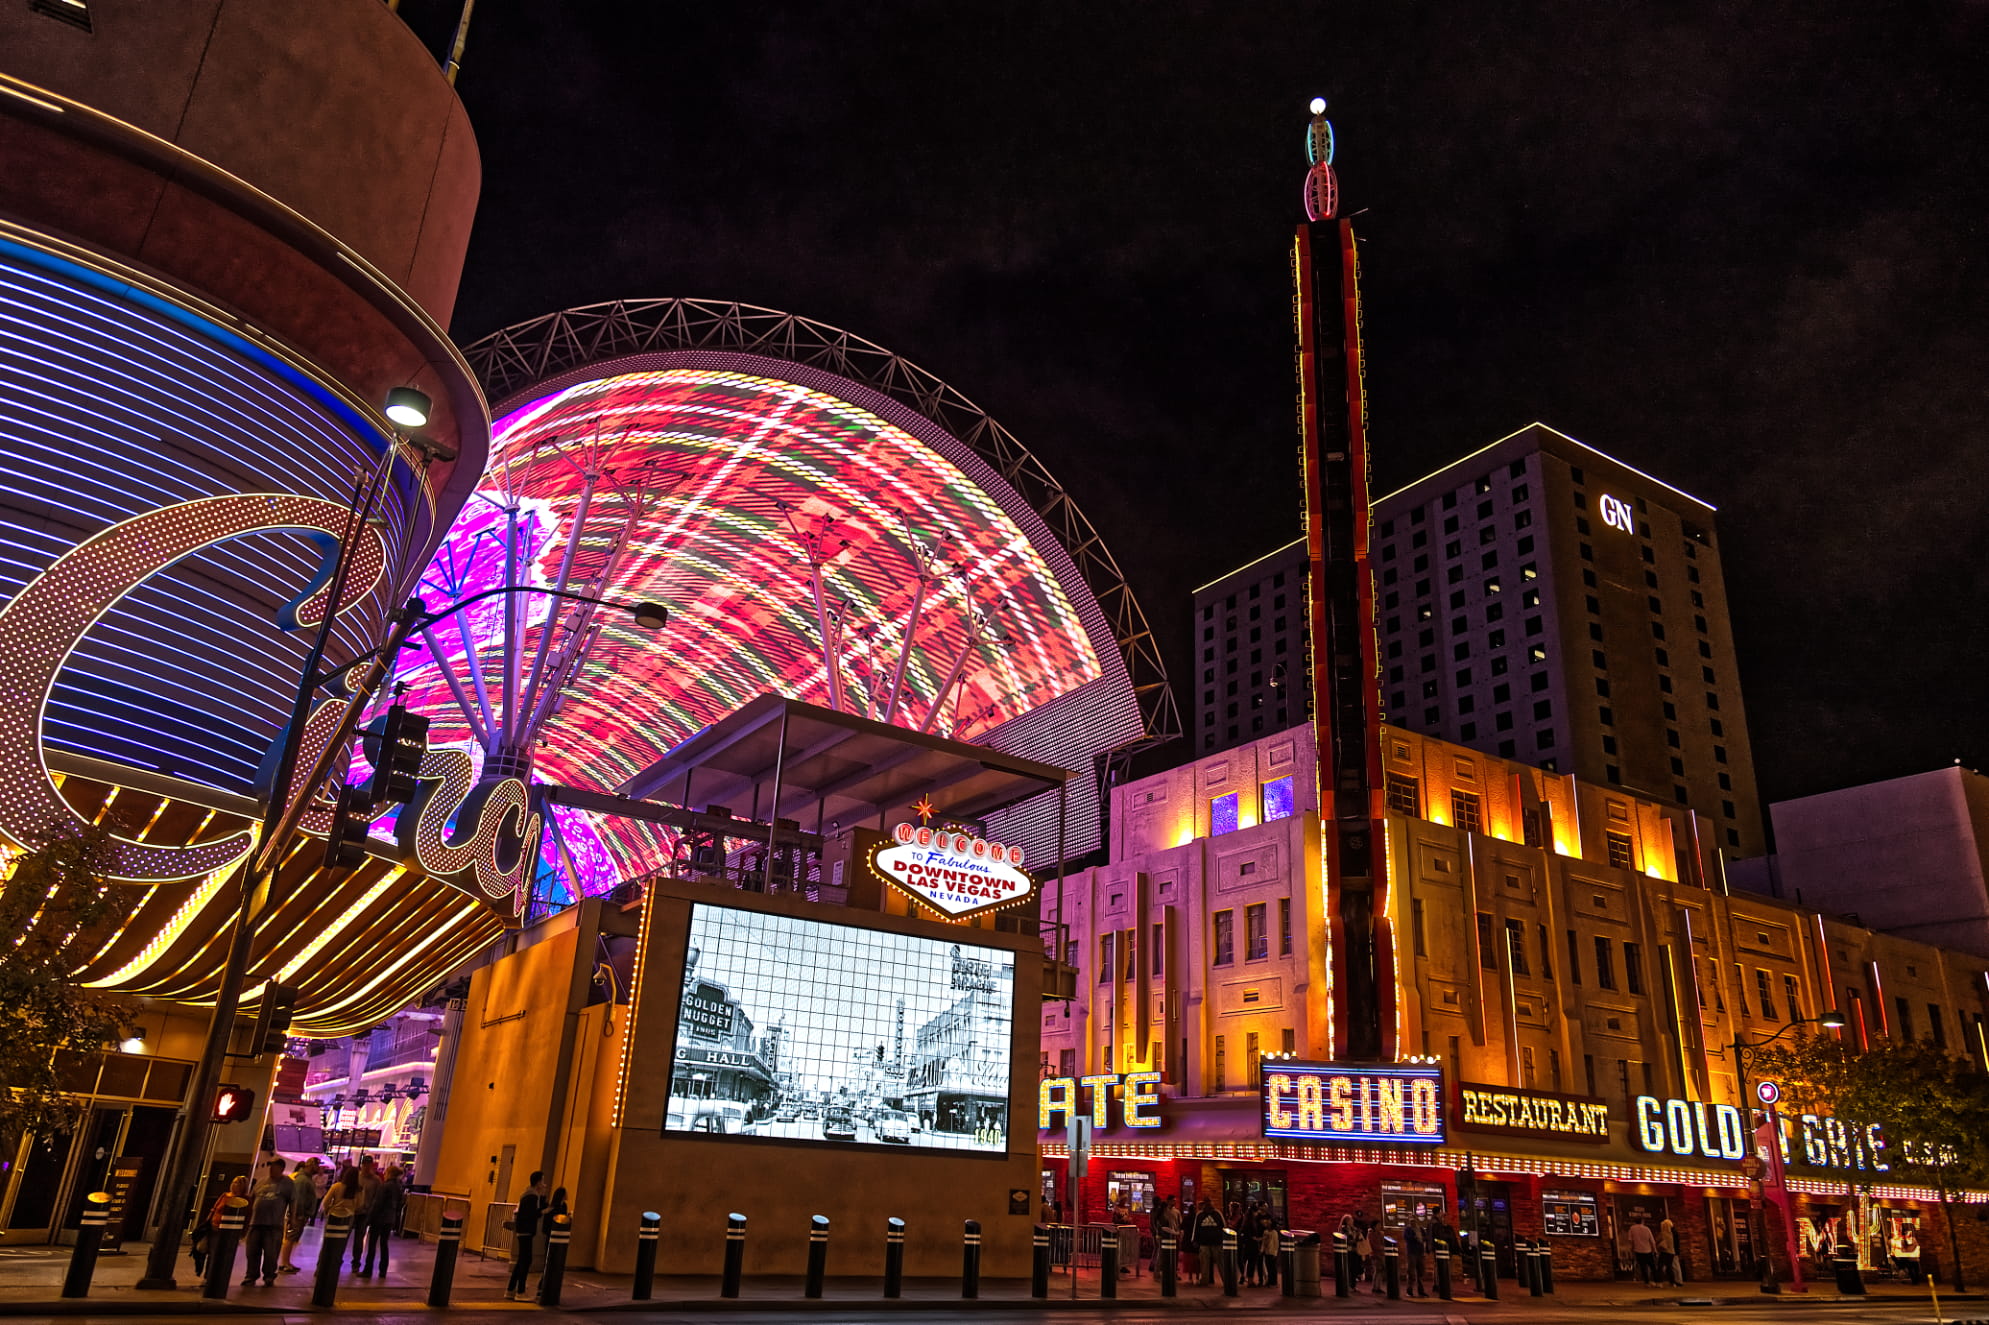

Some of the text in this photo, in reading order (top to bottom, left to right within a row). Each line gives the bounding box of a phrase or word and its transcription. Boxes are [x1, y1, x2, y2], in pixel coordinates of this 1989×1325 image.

[1600, 493, 1634, 536] GN
[897, 823, 1023, 866] WELCOME
[911, 851, 992, 873] TO Fabulous
[893, 860, 1016, 892] DOWNTOWN
[906, 874, 1003, 900] LAS VEGAS
[929, 890, 979, 905] NEVADA
[683, 1008, 731, 1028] NUGGET
[686, 995, 732, 1017] GOLDEN
[706, 1051, 750, 1066] HALL
[1268, 1074, 1438, 1135] CASINO
[1463, 1089, 1608, 1136] RESTAURANT
[974, 1128, 1001, 1145] 1940
[1637, 1095, 1791, 1165] GOLD
